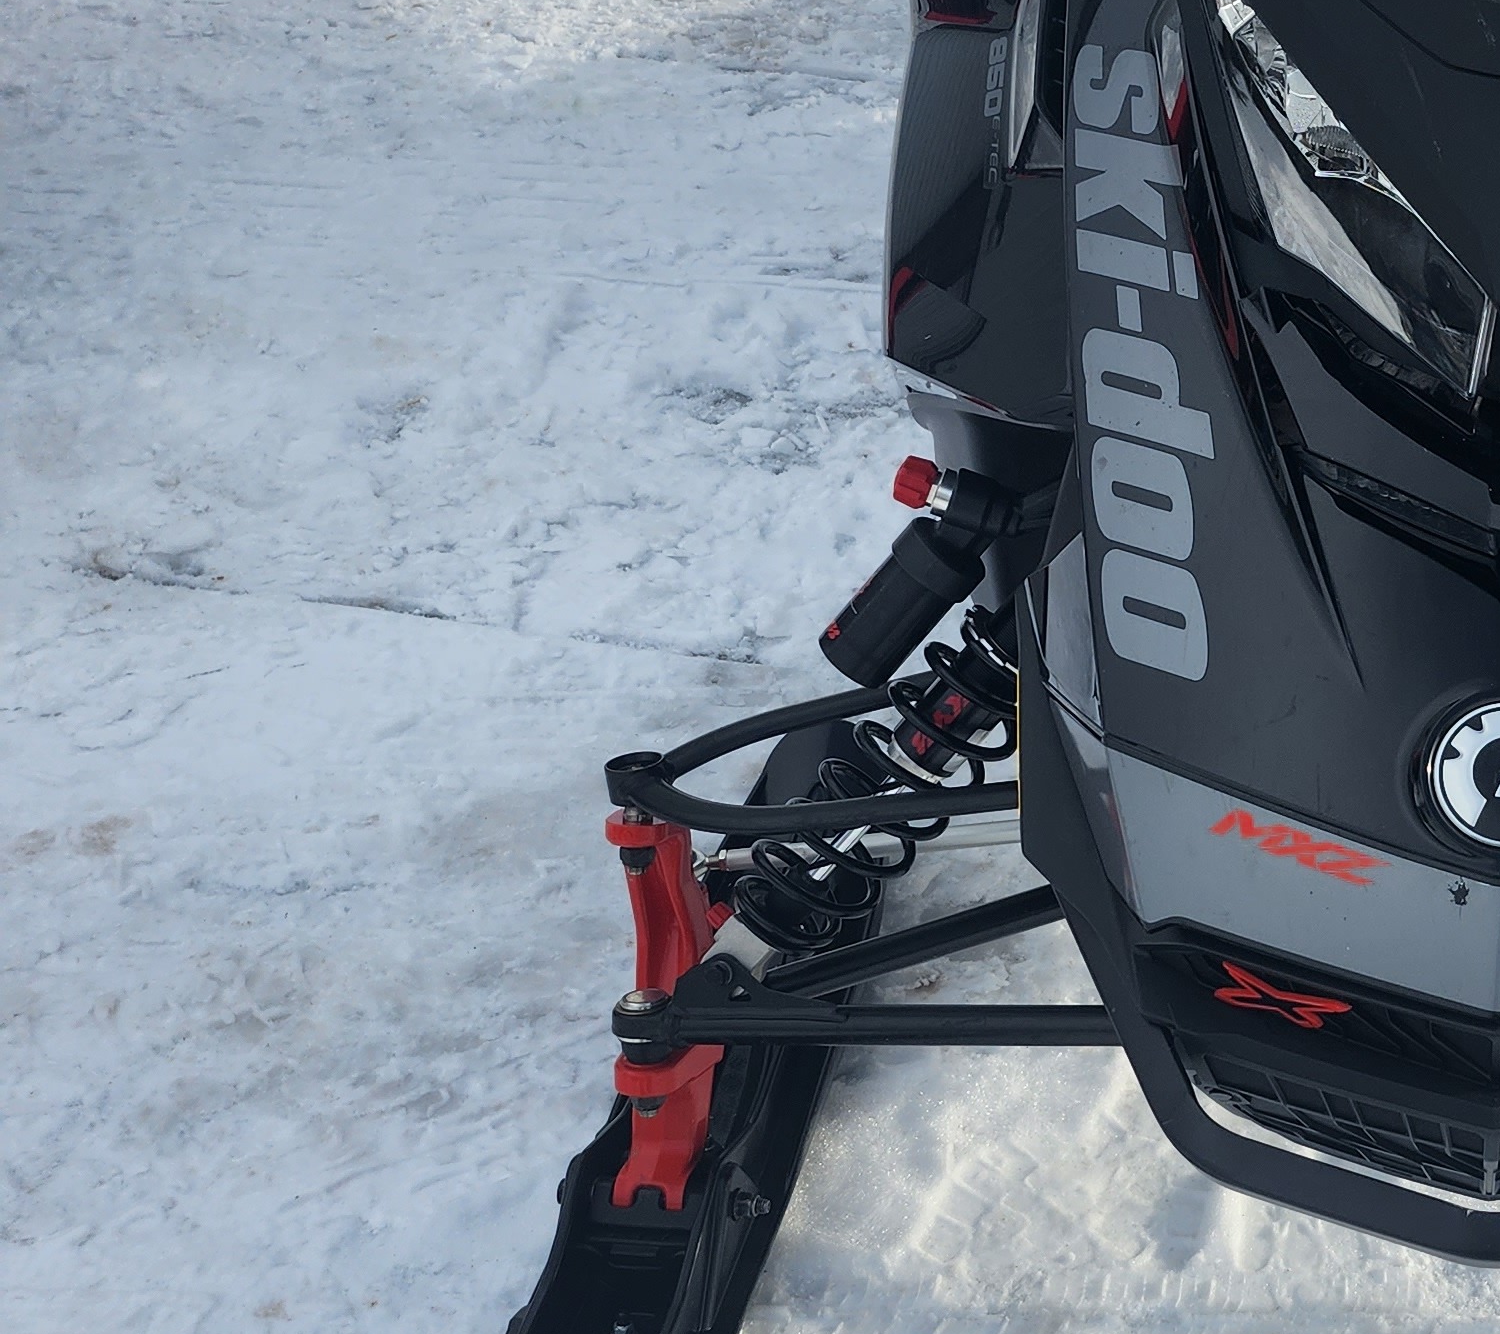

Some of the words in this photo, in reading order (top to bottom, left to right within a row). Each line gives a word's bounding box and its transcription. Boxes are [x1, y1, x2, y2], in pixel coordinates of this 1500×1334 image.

[984, 36, 1008, 117] 850
[1073, 43, 1216, 682] ski-doo
[1208, 807, 1392, 886] MXZ
